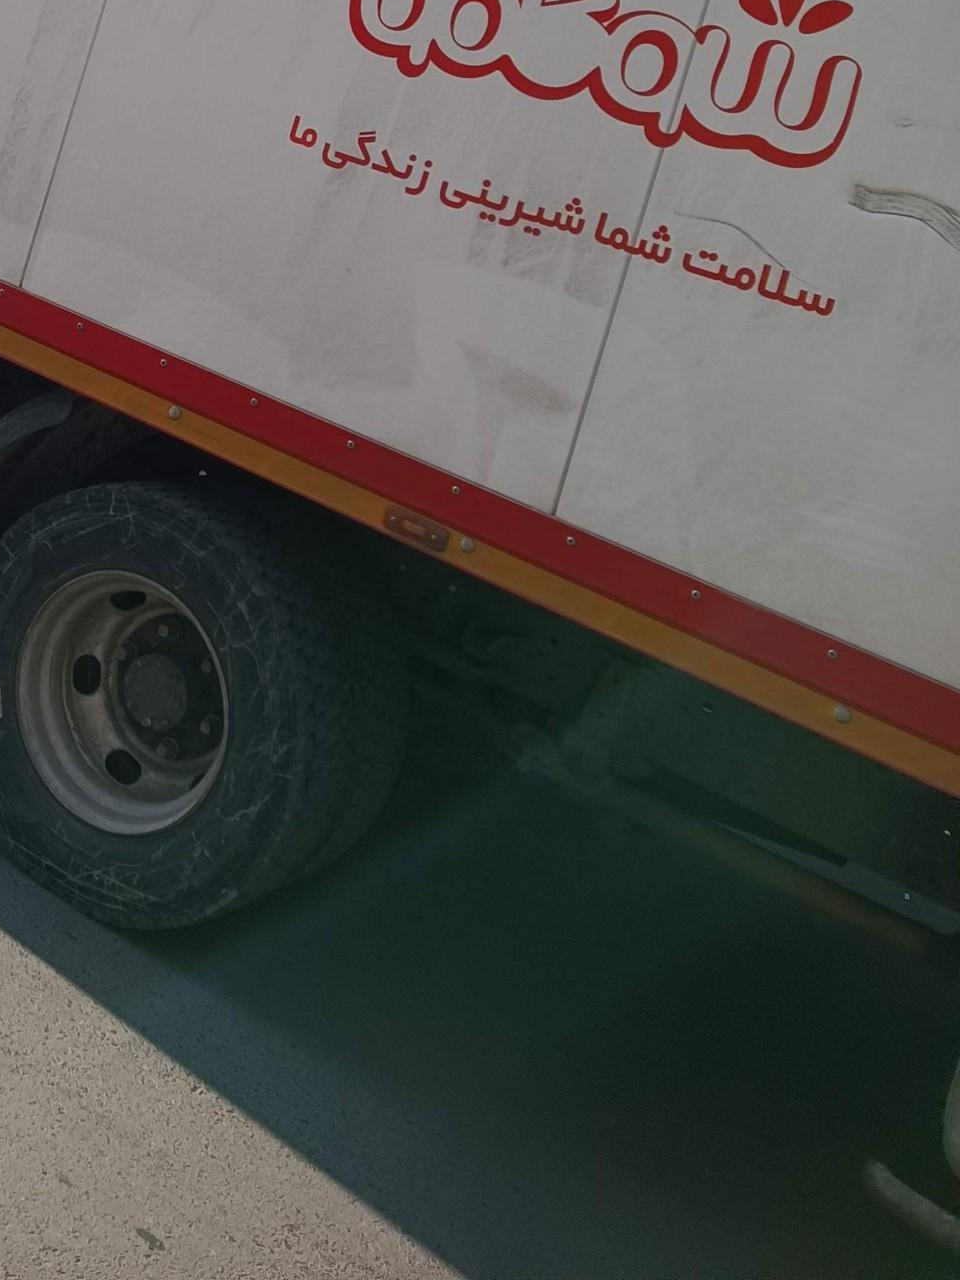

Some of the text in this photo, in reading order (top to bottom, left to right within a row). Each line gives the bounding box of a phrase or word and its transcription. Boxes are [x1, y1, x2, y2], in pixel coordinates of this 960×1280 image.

[288, 115, 837, 318] سلامت شما شیرینی زندگی ما
